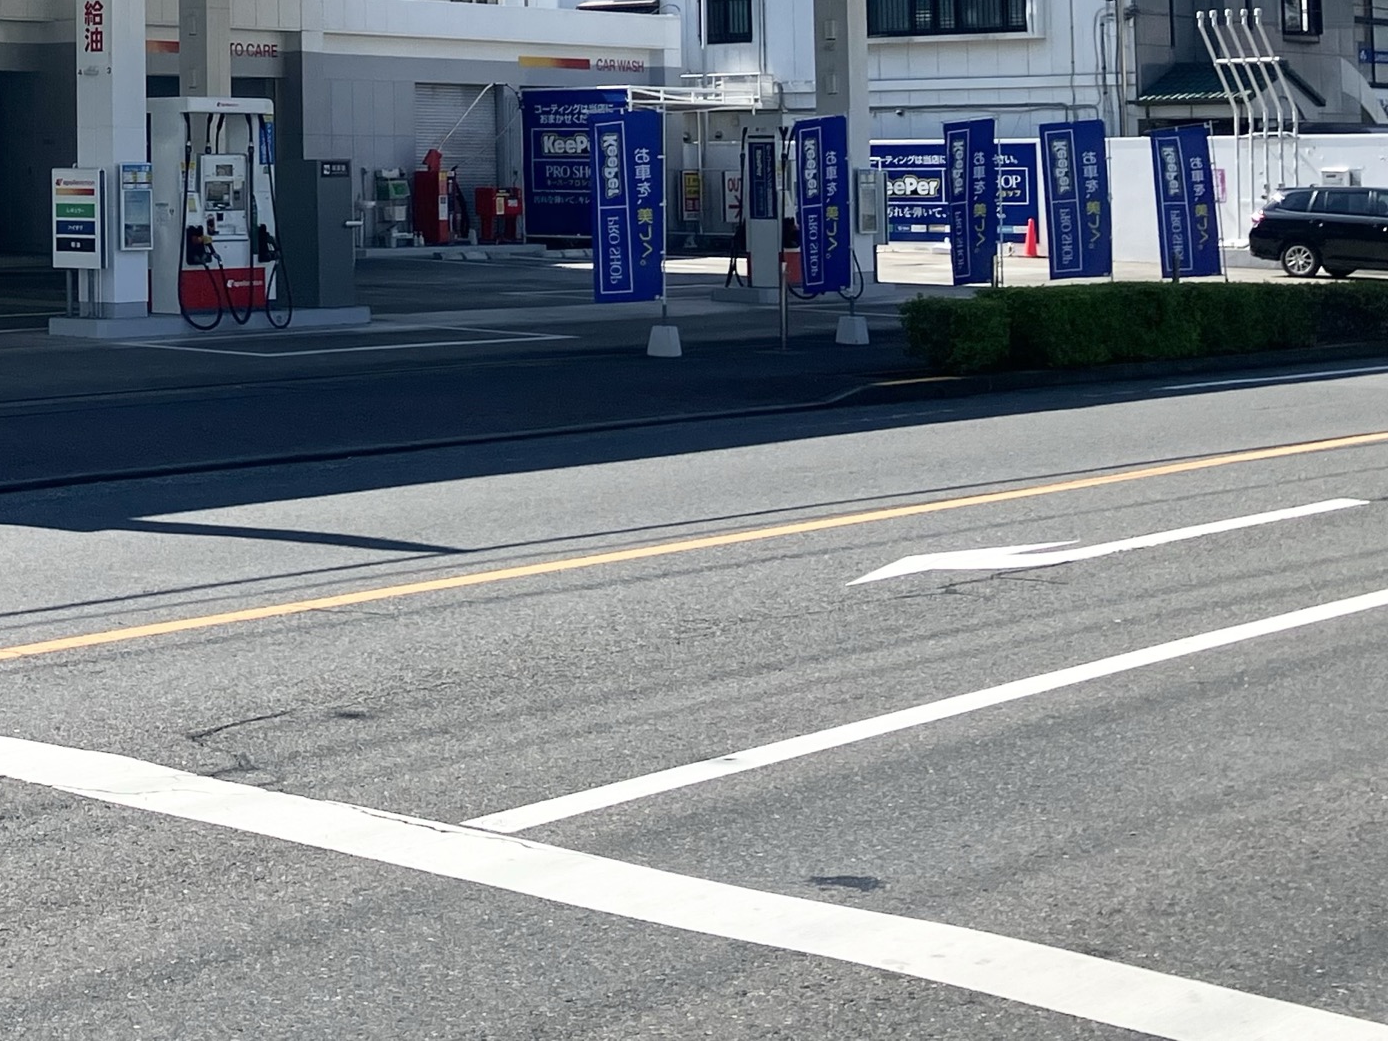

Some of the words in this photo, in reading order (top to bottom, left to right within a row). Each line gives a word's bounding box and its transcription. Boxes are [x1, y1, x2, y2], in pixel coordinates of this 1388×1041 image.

[246, 43, 279, 58] CARE
[596, 58, 615, 72] CAR
[616, 59, 644, 73] WASH
[543, 134, 590, 154] KeeP
[546, 165, 571, 179] PRO
[572, 165, 591, 179] SH
